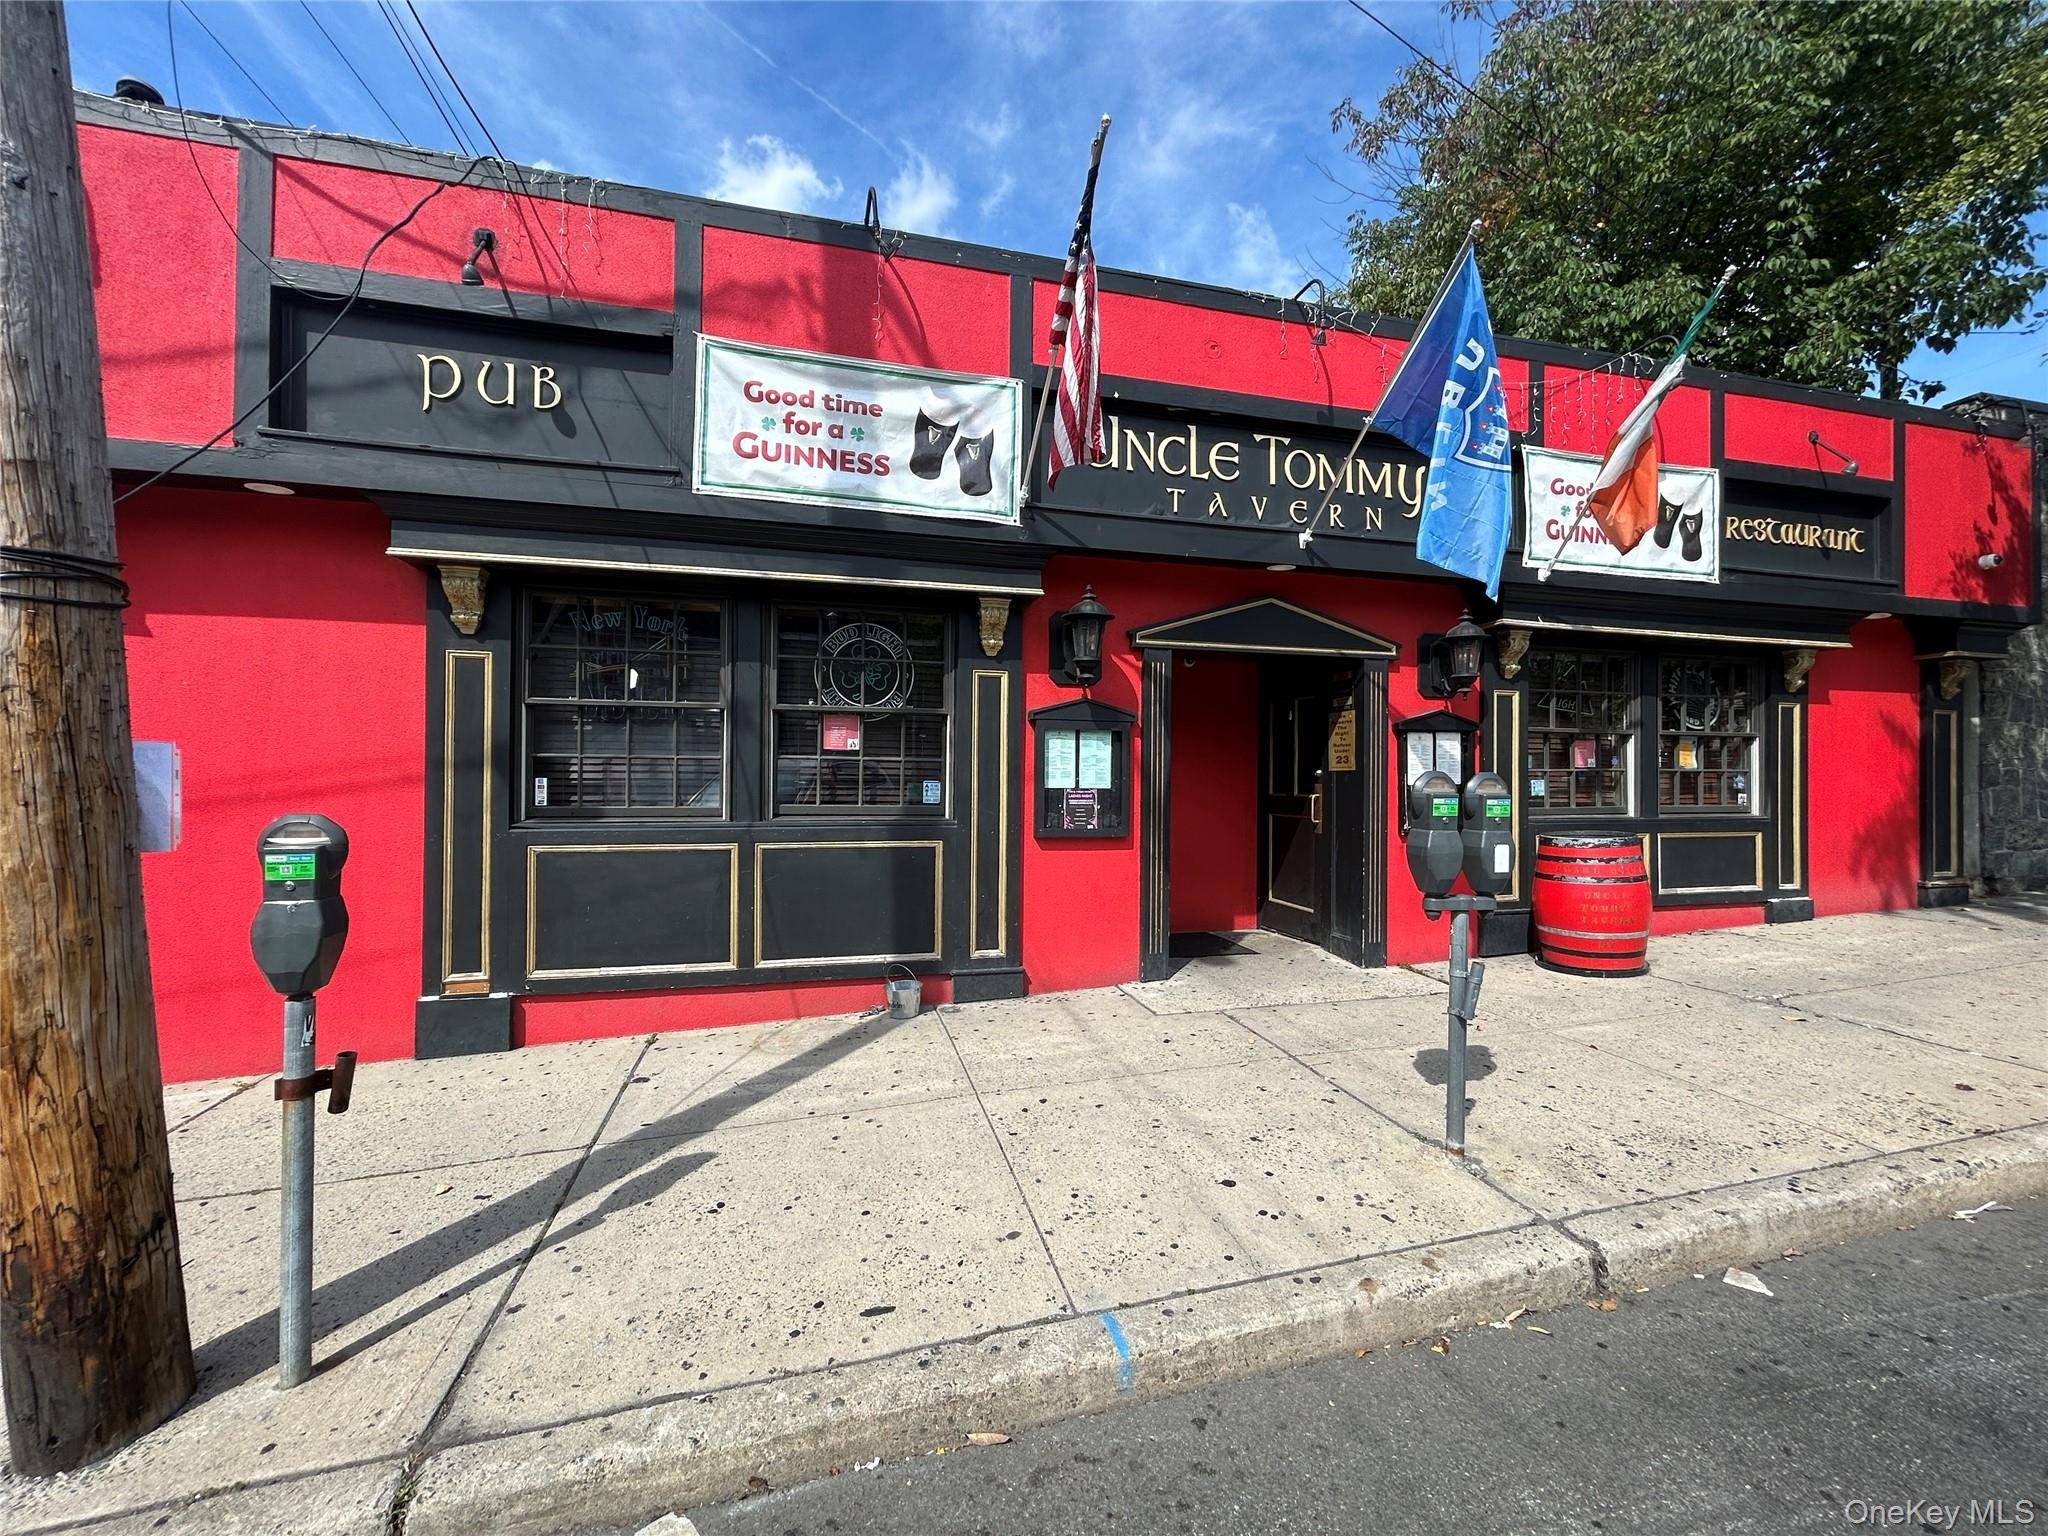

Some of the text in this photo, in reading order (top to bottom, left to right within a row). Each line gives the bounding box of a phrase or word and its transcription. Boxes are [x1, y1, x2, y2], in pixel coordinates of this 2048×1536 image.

[416, 353, 563, 412] PUB
[742, 380, 883, 418] Good time
[782, 411, 844, 440] for a
[732, 430, 891, 477] GUINNESS
[1089, 414, 1427, 519] UNCLE TOMMY
[1166, 487, 1383, 531] TAVERN
[568, 605, 689, 642] New York
[824, 626, 859, 654] BUD
[1336, 755, 1349, 764] 23
